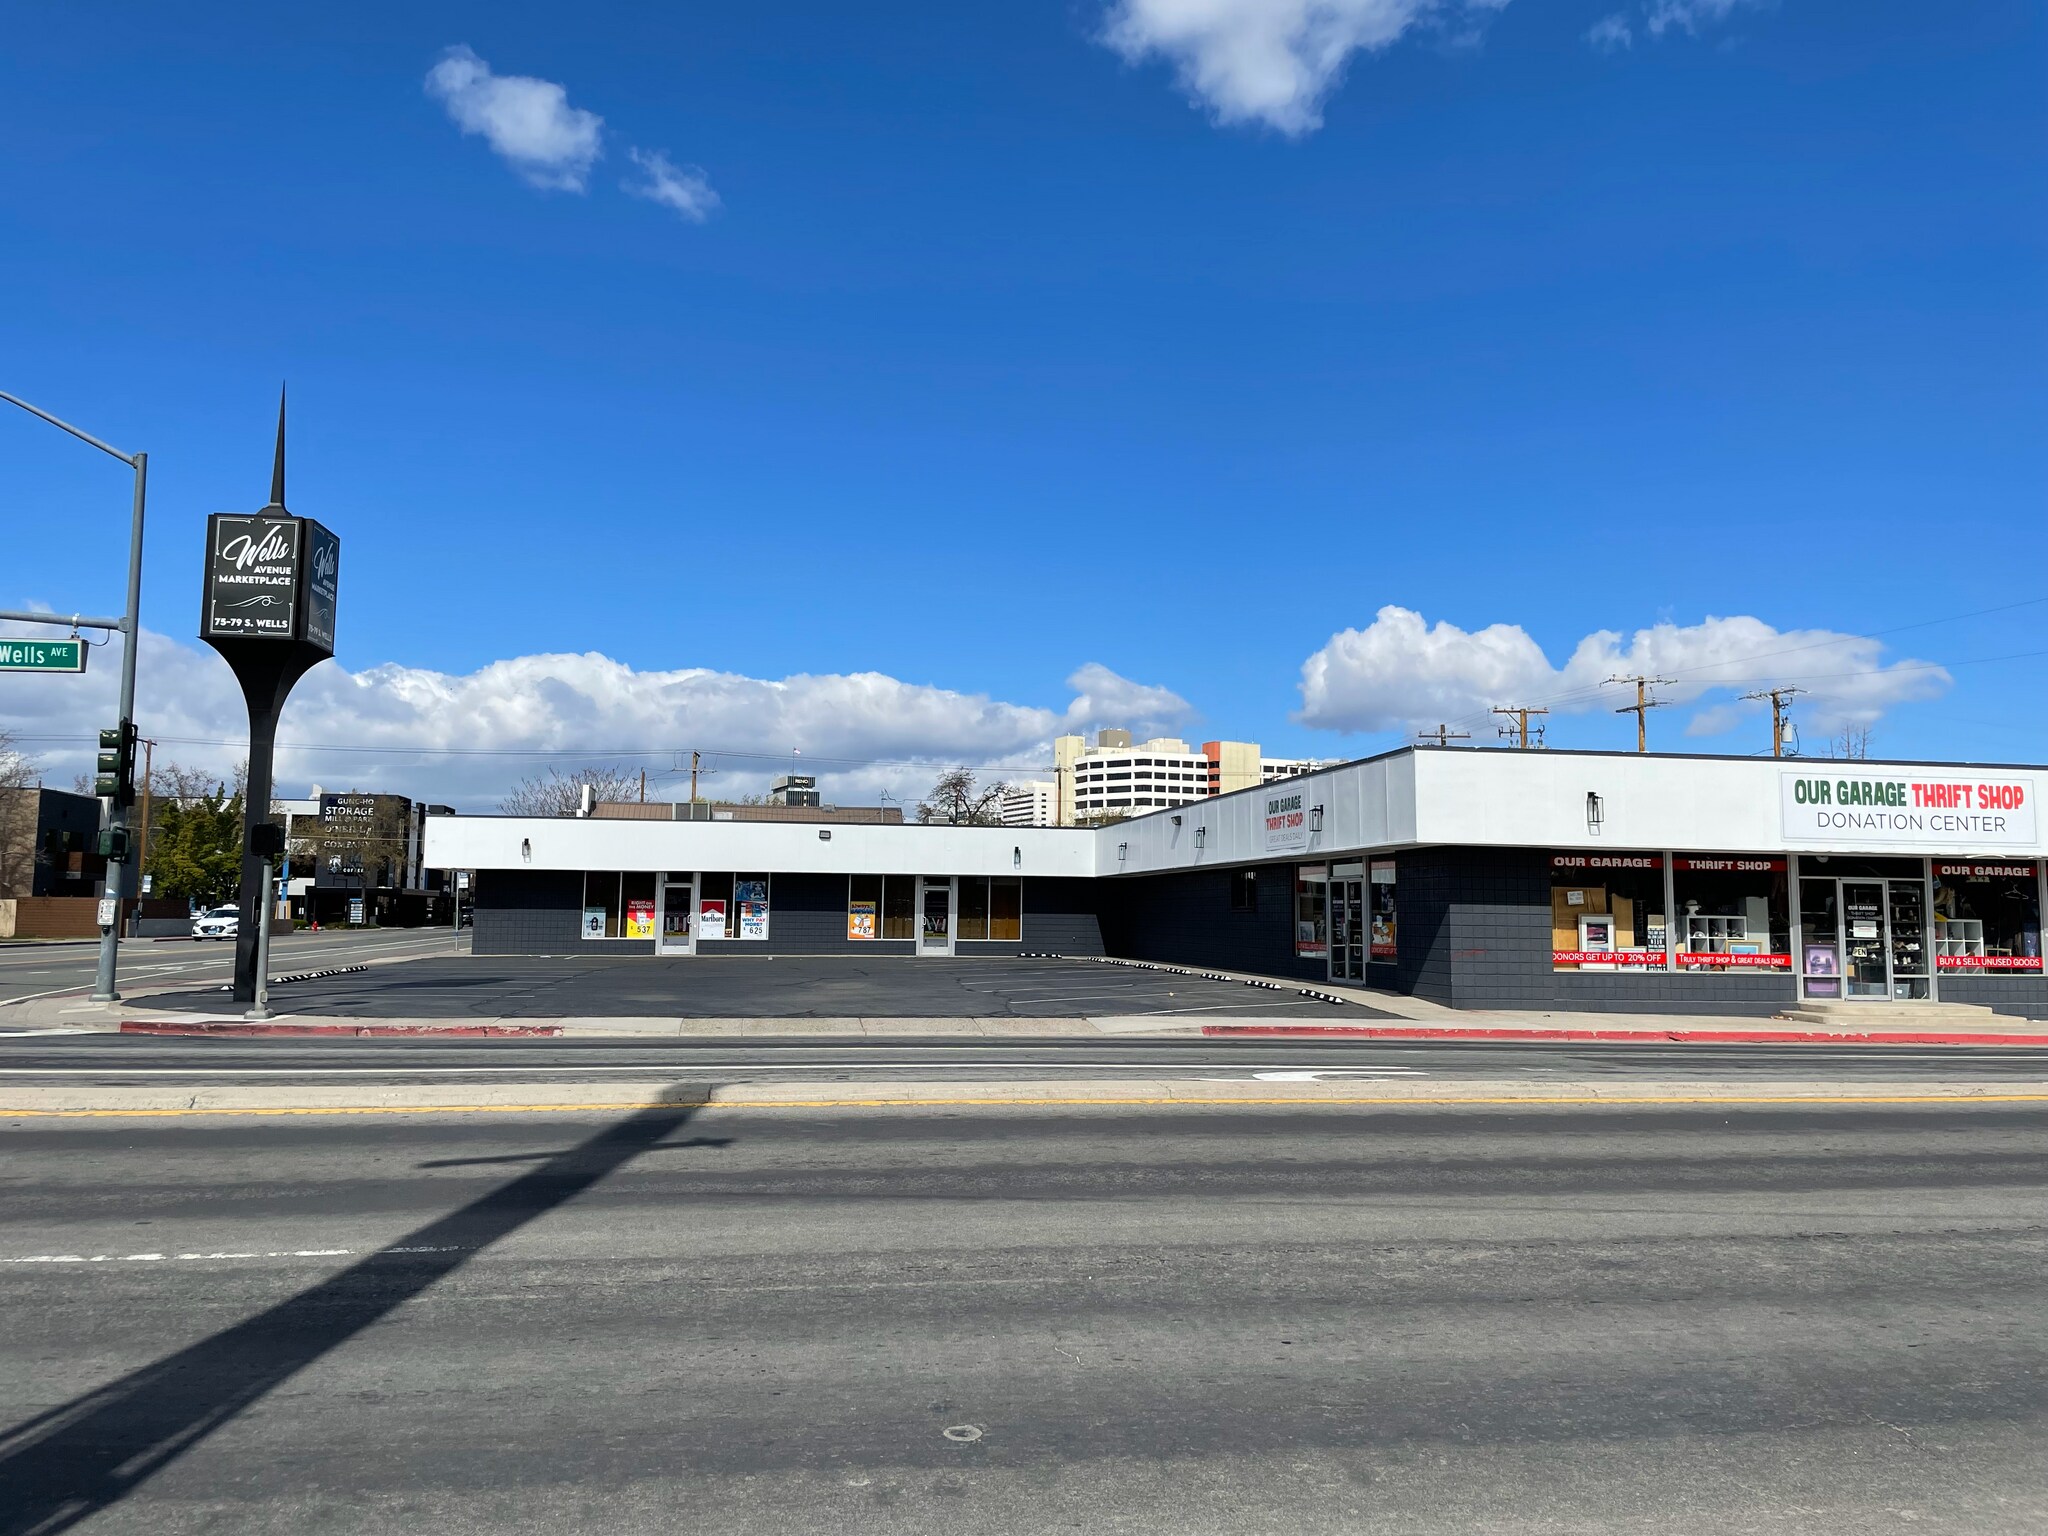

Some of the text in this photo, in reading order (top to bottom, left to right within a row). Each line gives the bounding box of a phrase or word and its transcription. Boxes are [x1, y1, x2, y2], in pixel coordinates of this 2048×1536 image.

[222, 525, 289, 570] Wells
[314, 542, 334, 580] Wells
[254, 566, 291, 574] AVENUE
[219, 575, 290, 585] MARKETPLACE
[214, 618, 288, 628] 75-79 S. WELLS
[0, 645, 68, 663] Wells AVE
[1794, 779, 2024, 810] OUR GARAGE THRIFT SHOP
[1269, 795, 1301, 814] OUR GARAGE
[325, 806, 374, 816] STORAGE
[1266, 812, 1303, 830] THRIFT SHOP
[1817, 812, 2006, 832] DONATION CENTER
[1554, 857, 1651, 868] OUR GARAGE
[1688, 860, 1771, 870] THRIFT SHOP
[1941, 866, 2030, 876] OUR GARAGE
[701, 914, 724, 922] Marlboro
[750, 926, 762, 934] 625
[1602, 953, 1612, 961] UP
[1731, 955, 1735, 963] &
[1981, 958, 2012, 966] UNUSED
[2013, 958, 2040, 966] GOODS
